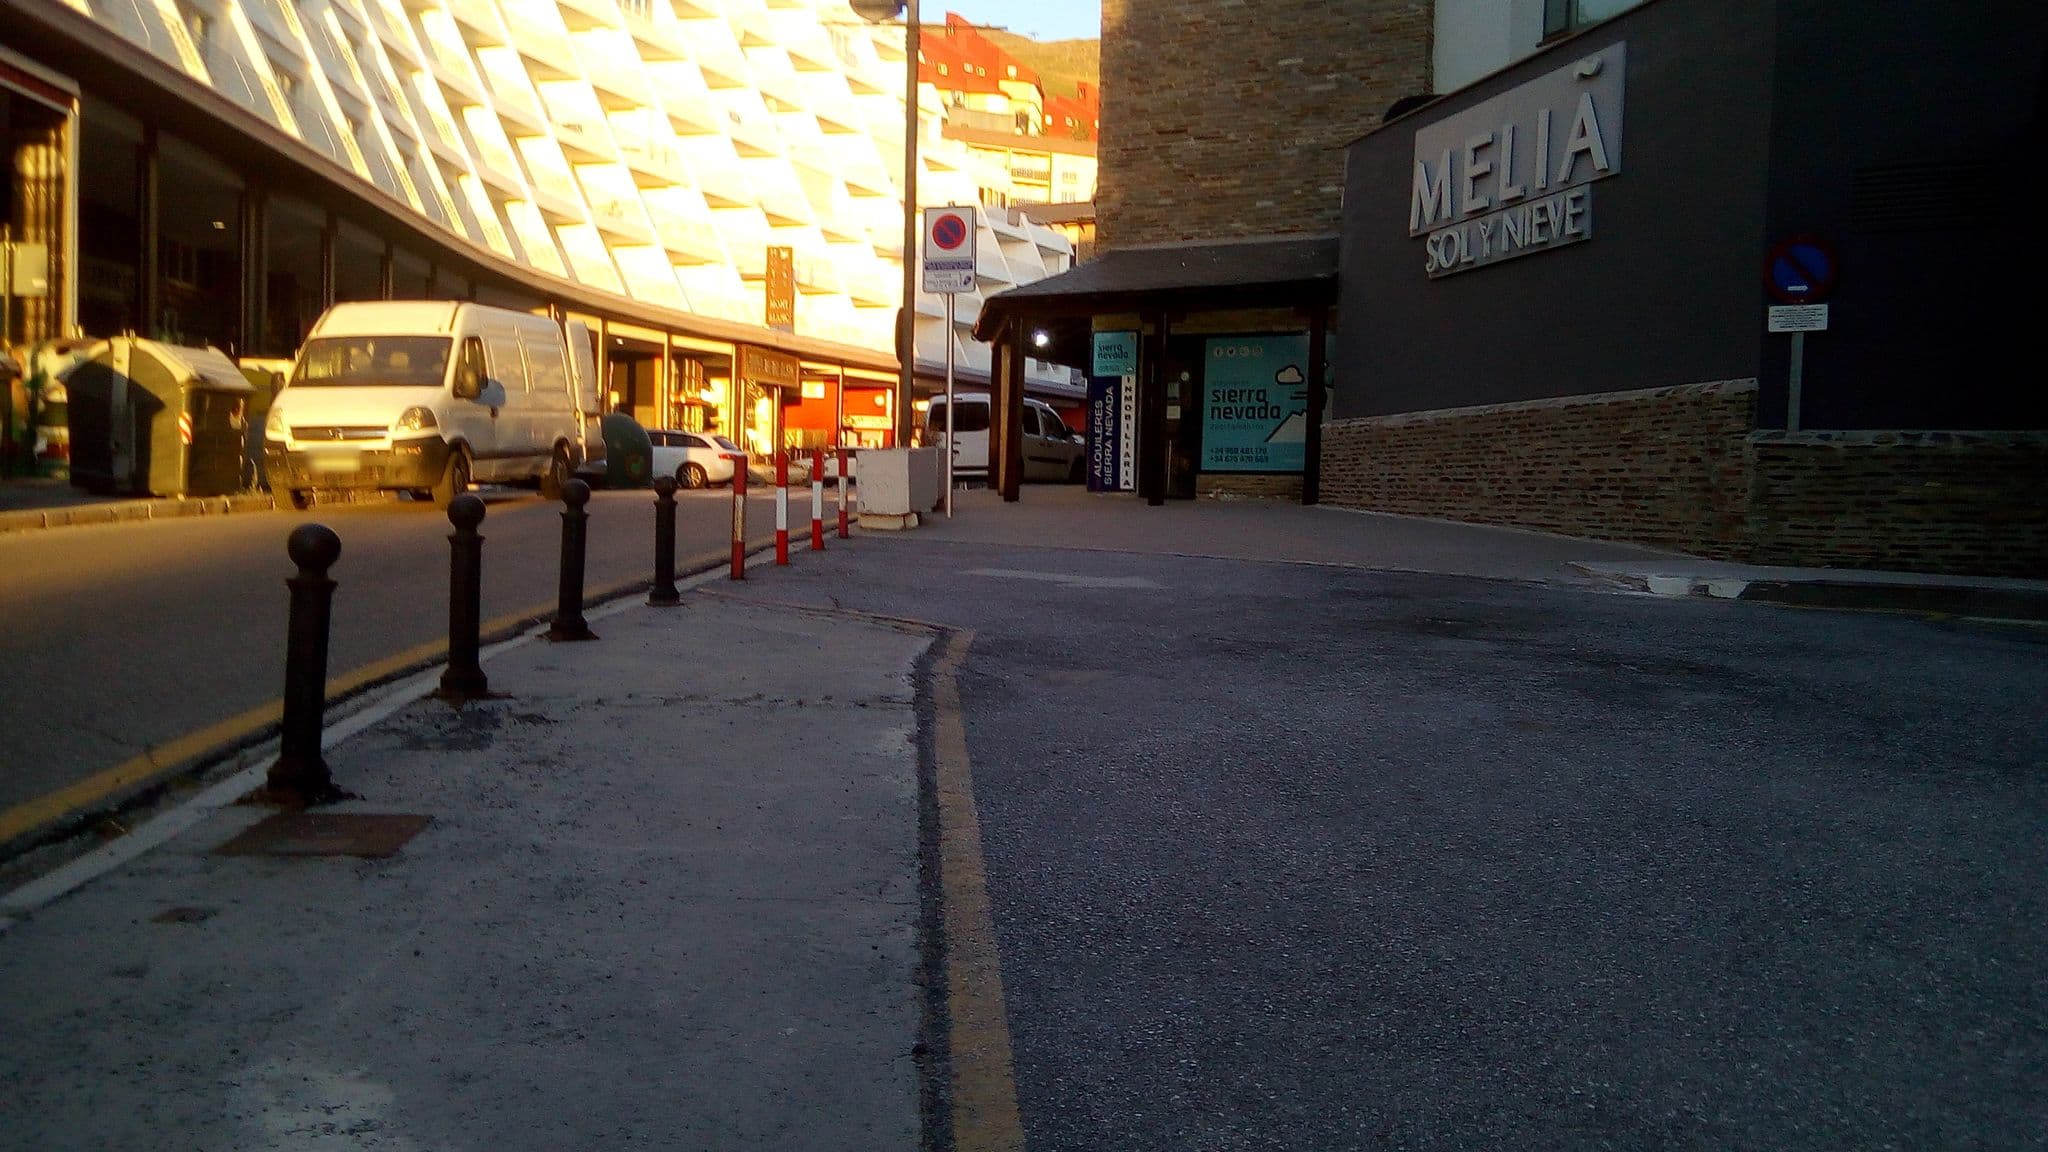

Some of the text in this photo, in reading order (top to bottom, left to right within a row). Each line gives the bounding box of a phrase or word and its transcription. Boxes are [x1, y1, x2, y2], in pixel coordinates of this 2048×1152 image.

[1424, 191, 1586, 273] SOL Y NIEVE
[1097, 351, 1129, 360] nevada
[1098, 343, 1123, 353] sierra
[1104, 385, 1115, 437] NEVADA
[1210, 402, 1281, 420] nevada
[1211, 388, 1269, 403] sierra
[1093, 399, 1104, 478] ALQUILERES
[1123, 376, 1134, 487] INMOBILIARIA
[1103, 440, 1113, 486] SIERRA
